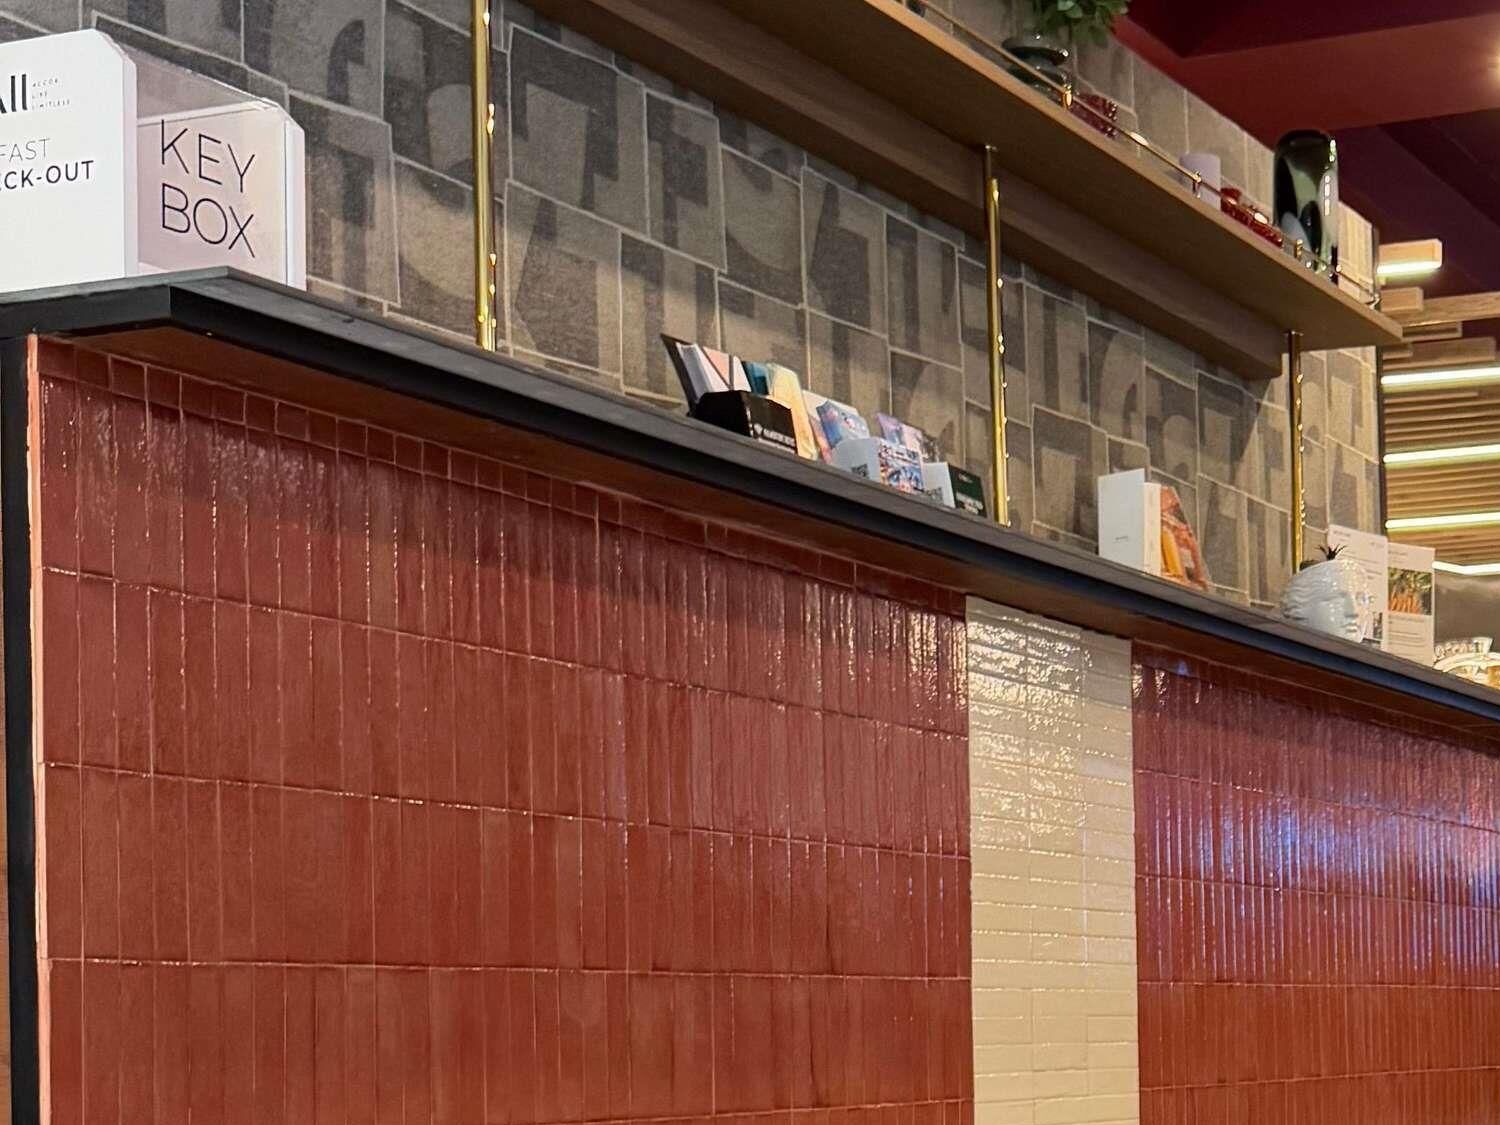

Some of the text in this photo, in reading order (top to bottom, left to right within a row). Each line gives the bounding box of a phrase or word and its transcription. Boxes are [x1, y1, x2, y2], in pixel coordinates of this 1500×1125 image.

[0, 160, 95, 190] CK-OUT
[161, 119, 256, 193] KEY
[161, 183, 256, 259] BOX
